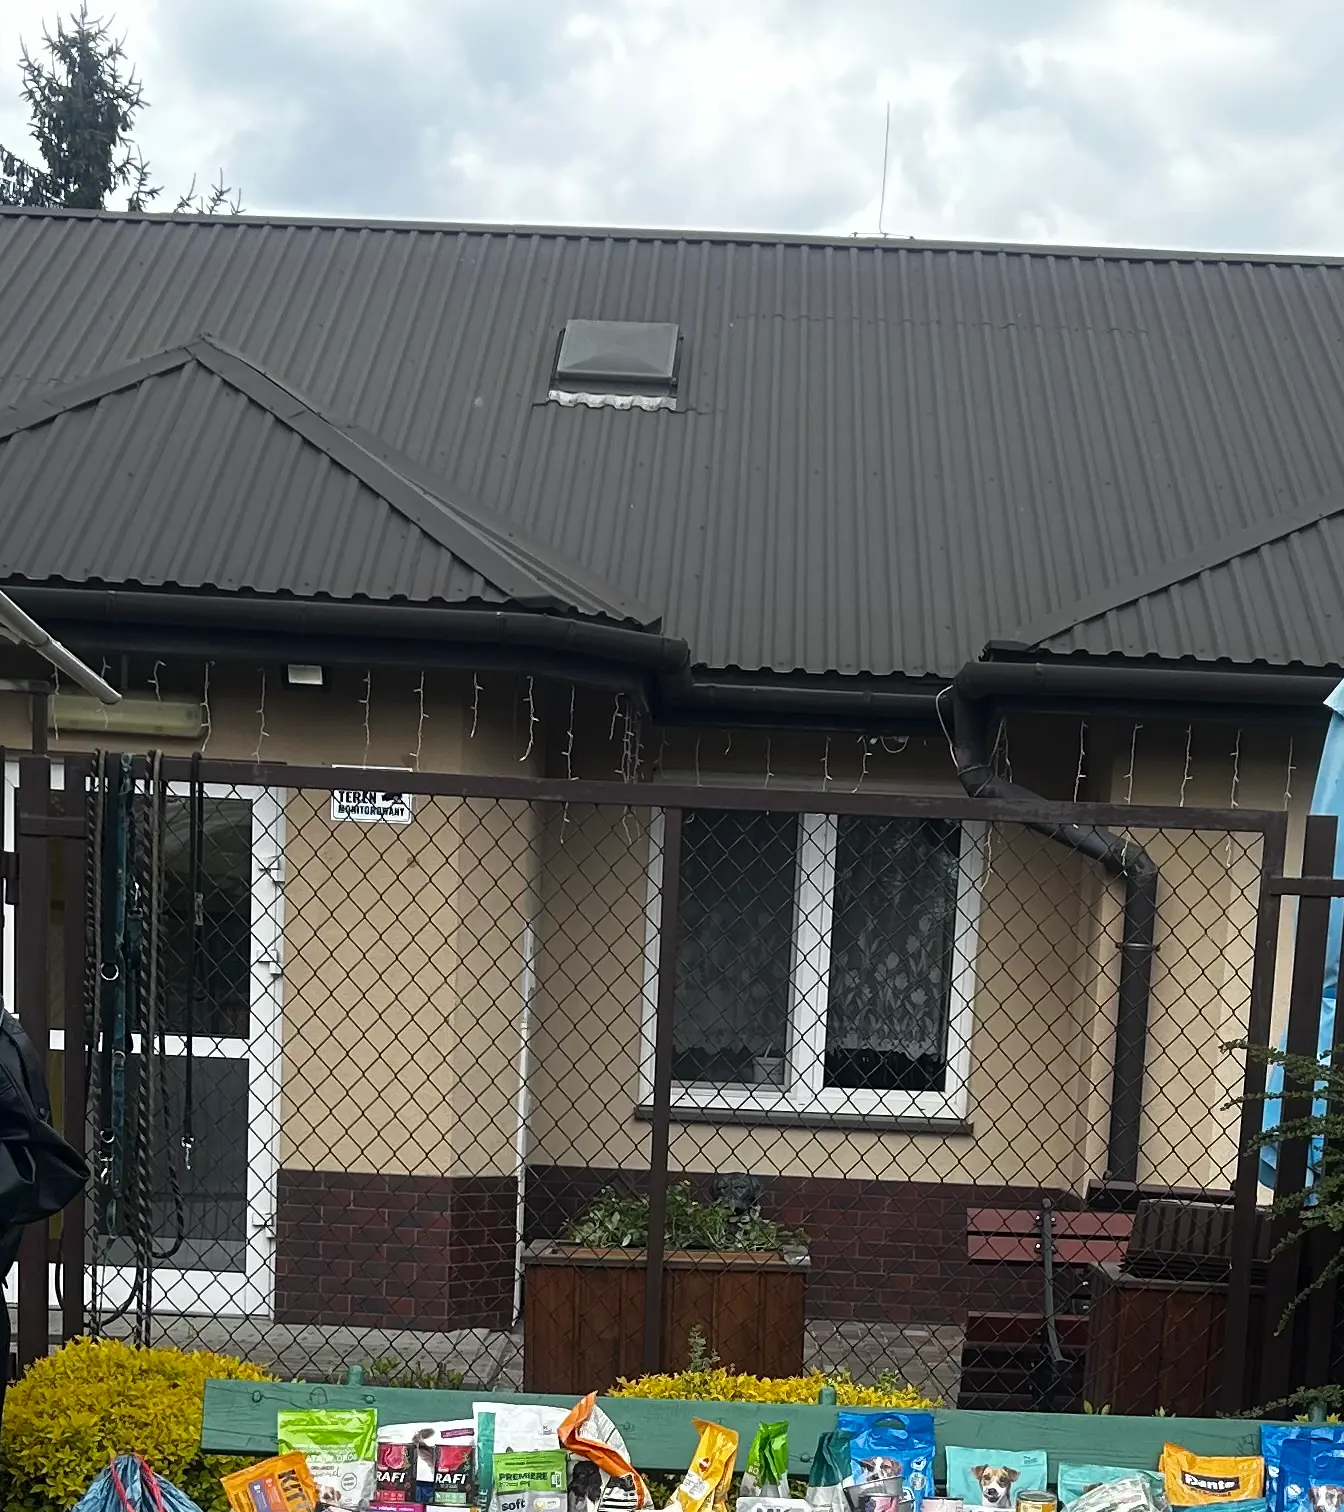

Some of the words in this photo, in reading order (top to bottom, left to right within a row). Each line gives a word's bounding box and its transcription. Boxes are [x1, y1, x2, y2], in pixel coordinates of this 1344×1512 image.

[376, 1471, 405, 1483] RAFI
[436, 1473, 467, 1484] RAFI
[501, 1499, 526, 1511] soft
